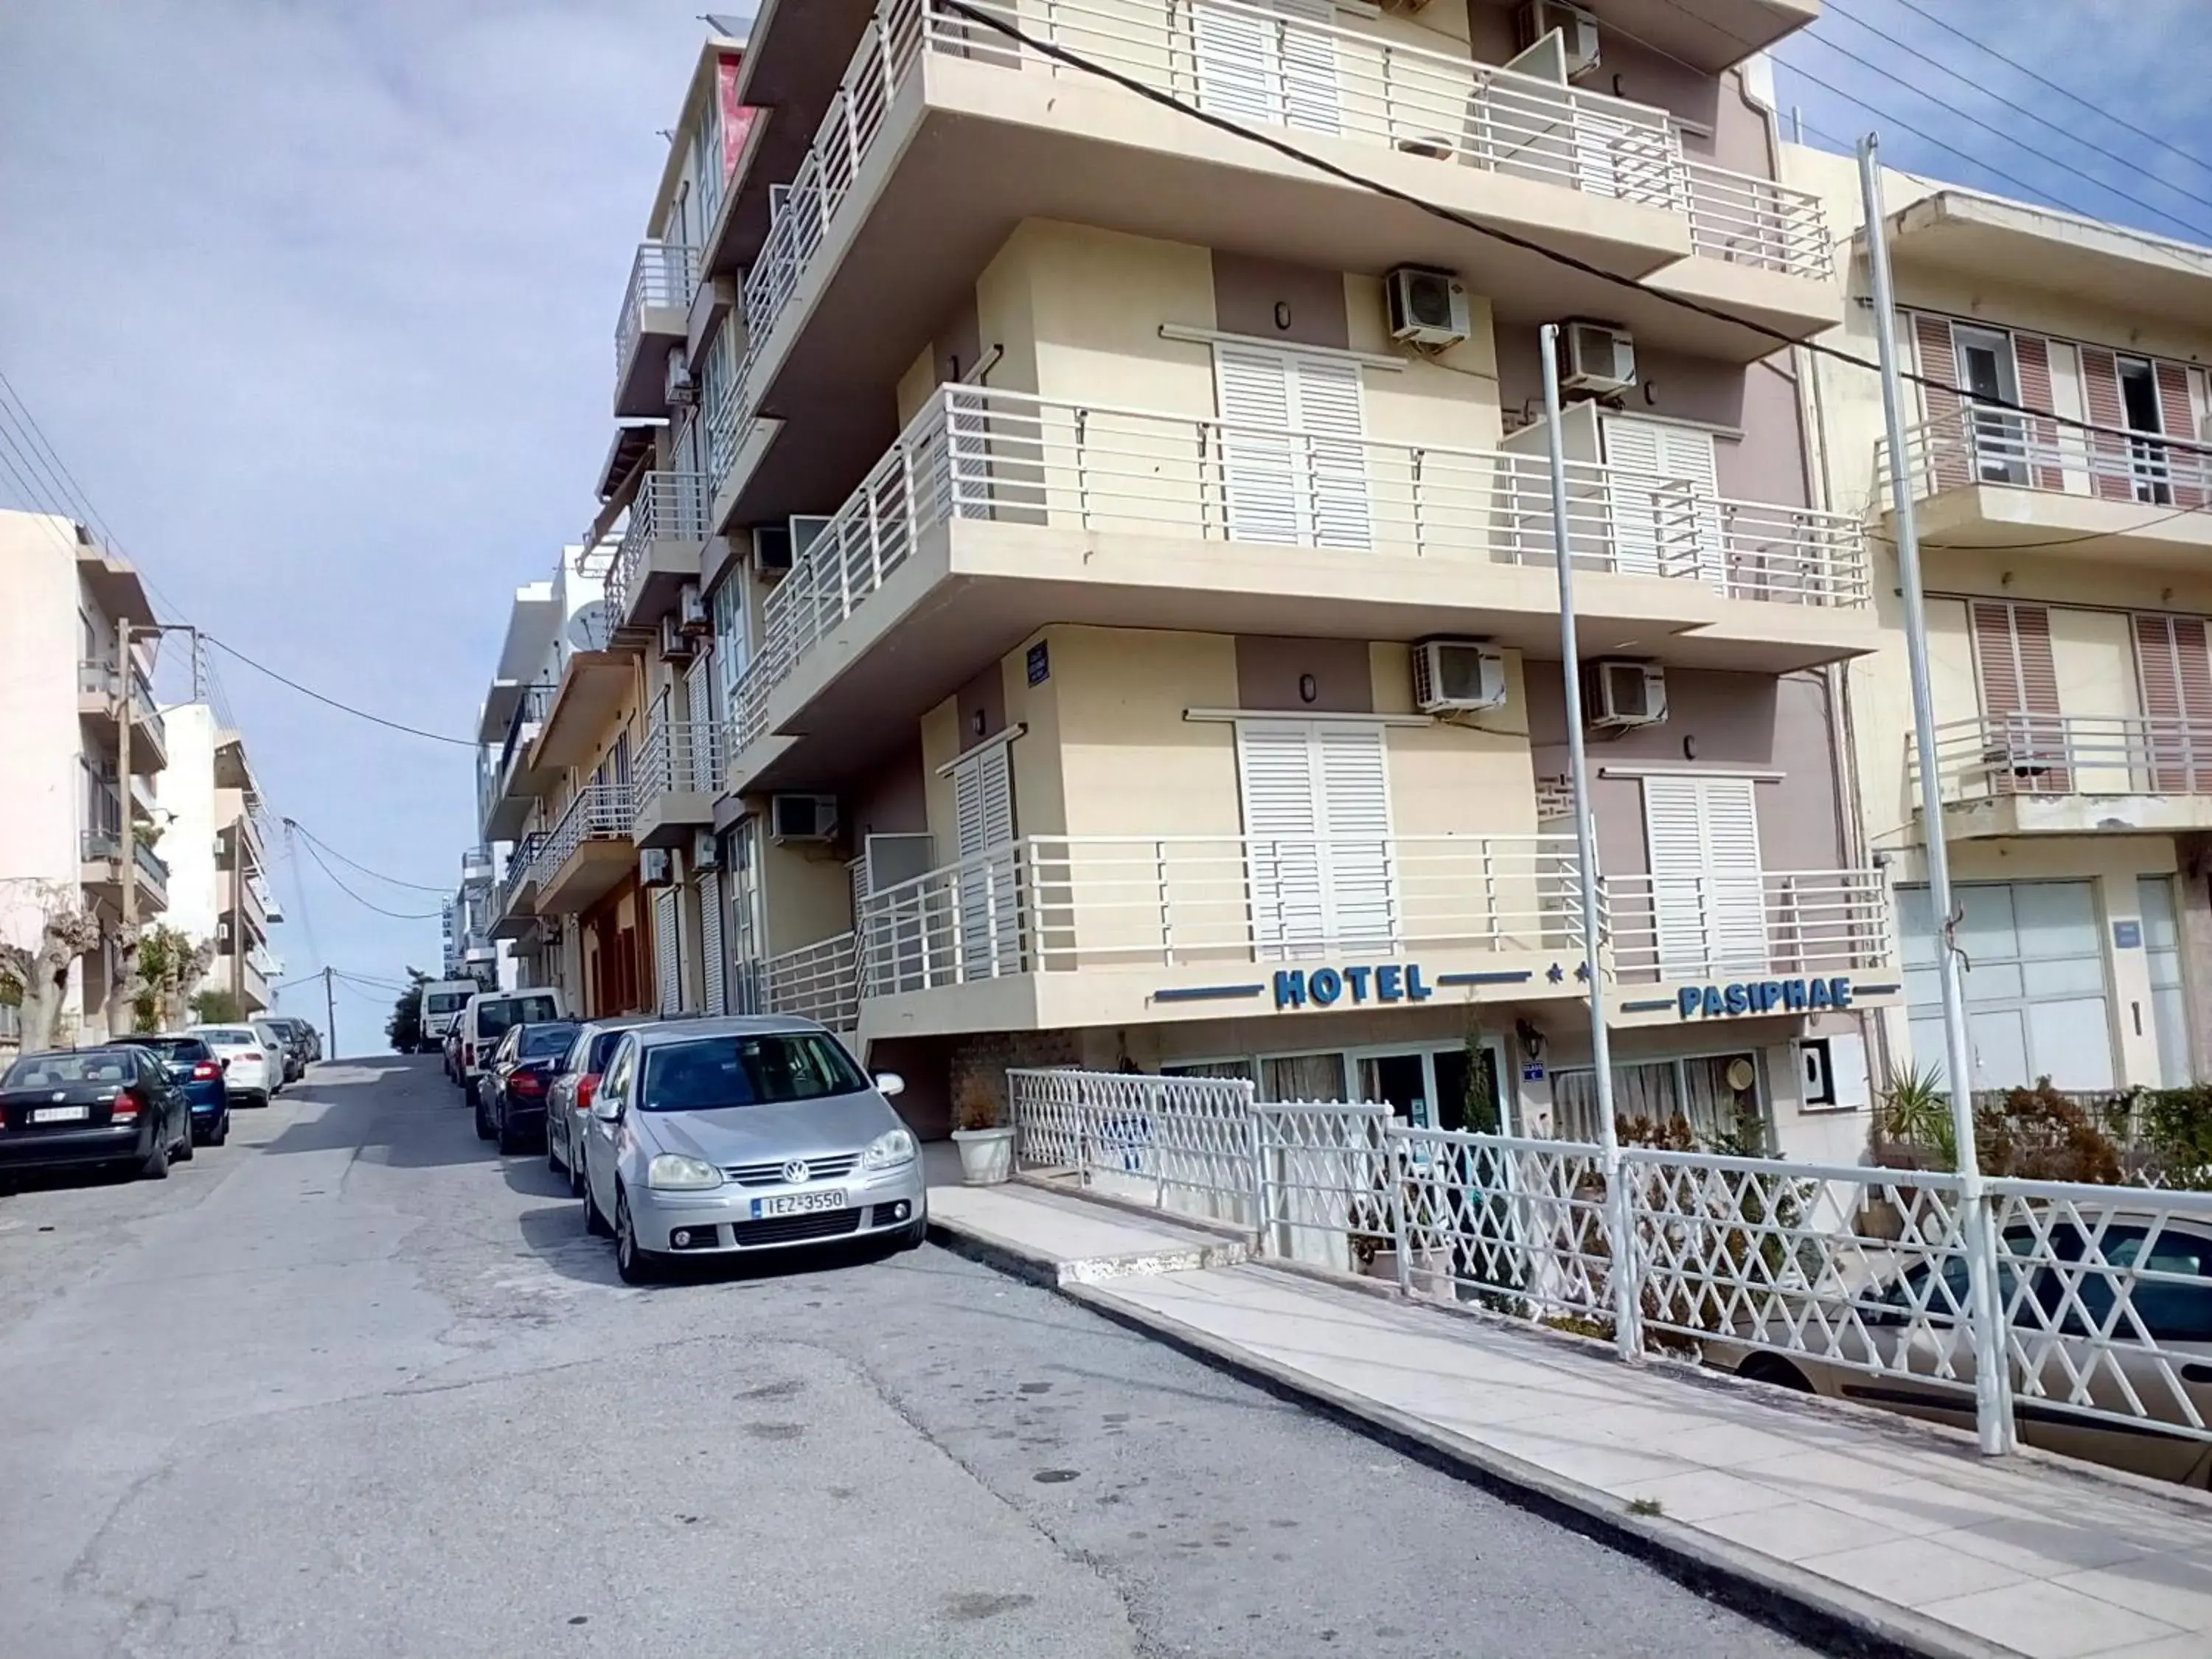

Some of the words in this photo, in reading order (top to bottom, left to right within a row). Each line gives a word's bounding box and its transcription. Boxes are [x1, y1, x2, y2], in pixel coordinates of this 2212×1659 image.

[1274, 964, 1432, 1010] HOTEL
[1678, 978, 1853, 1019] PASIPHAE
[768, 1192, 843, 1214] IEZ-3550
